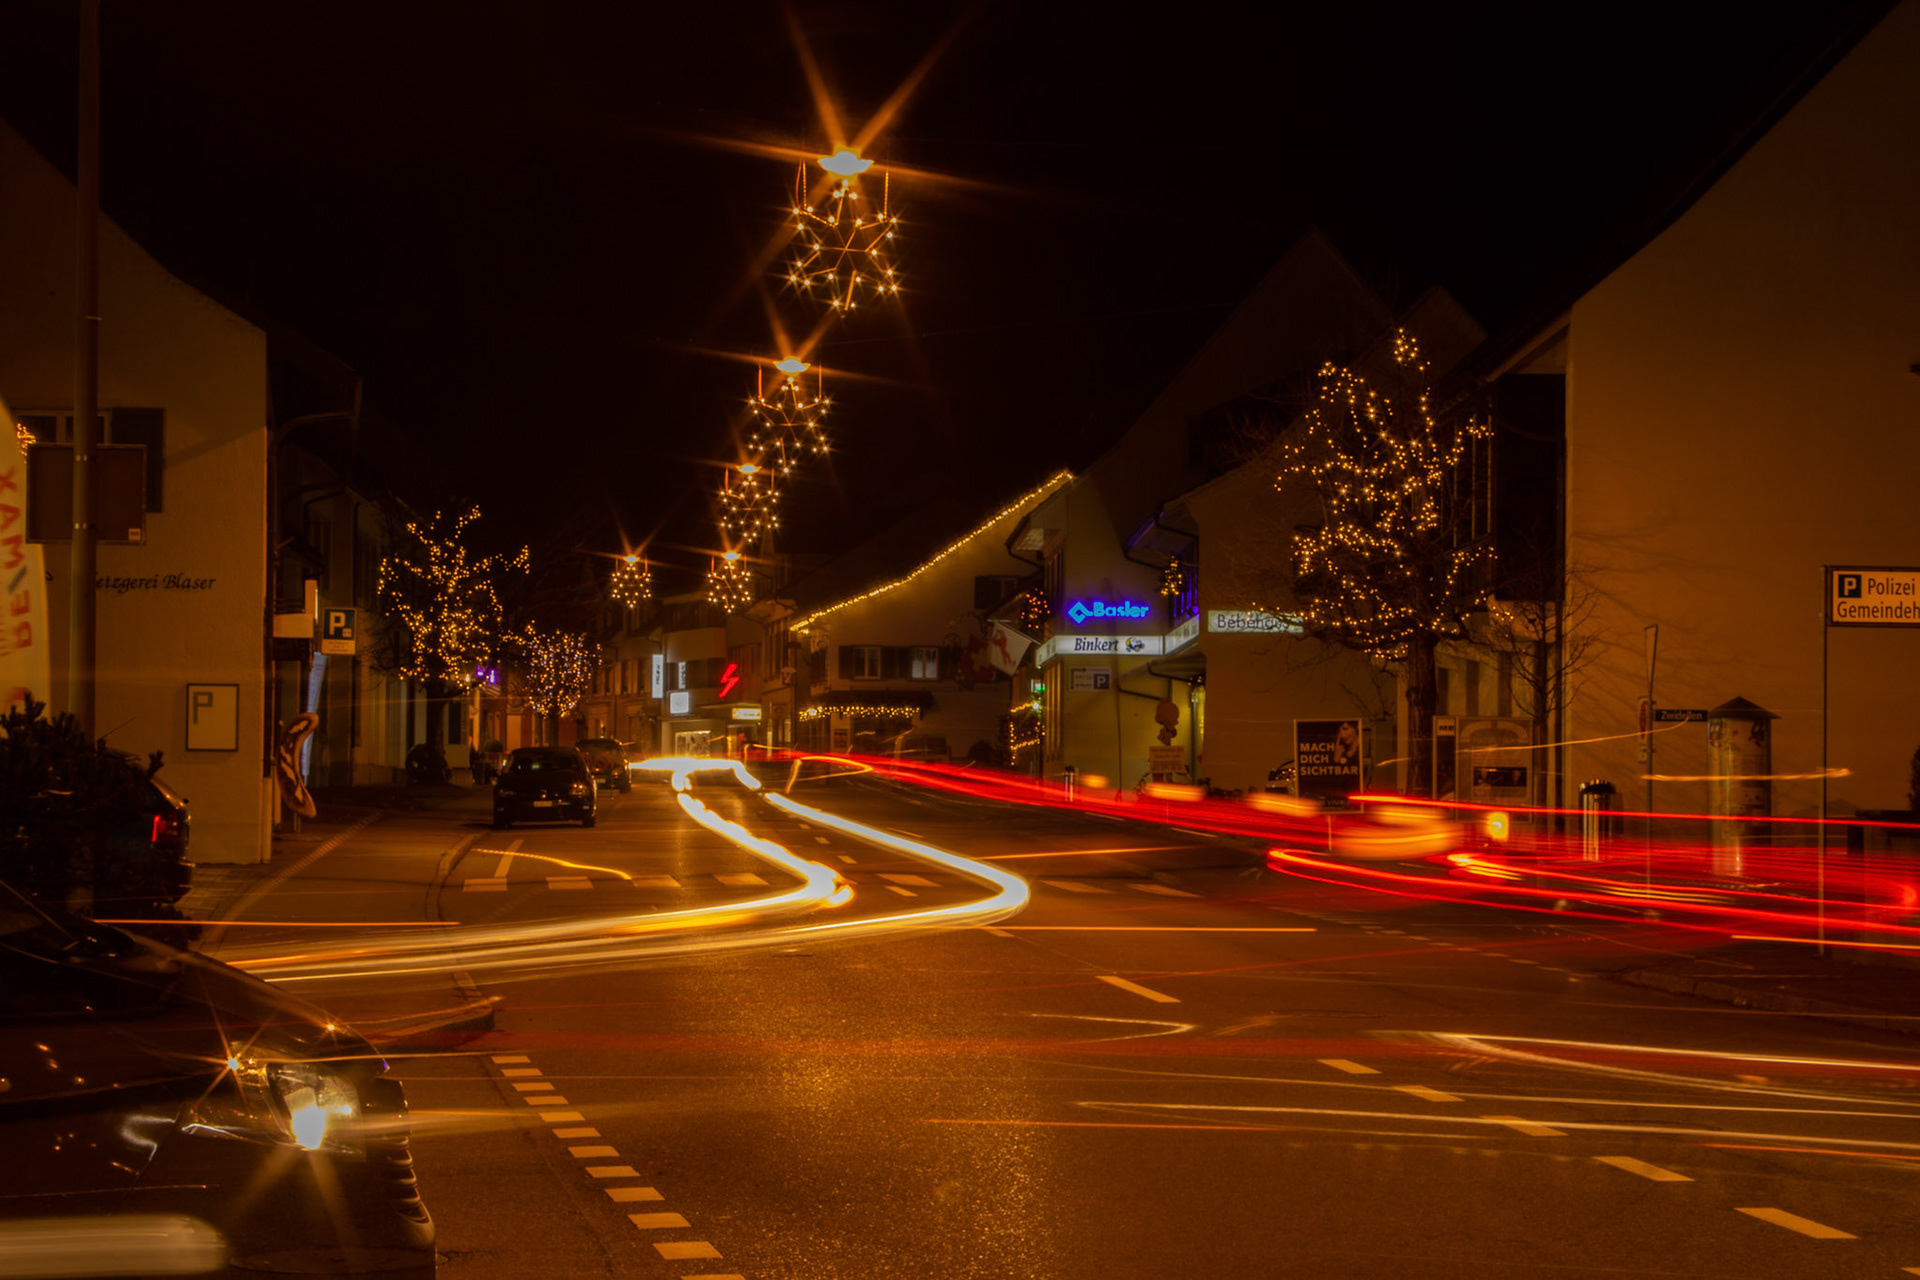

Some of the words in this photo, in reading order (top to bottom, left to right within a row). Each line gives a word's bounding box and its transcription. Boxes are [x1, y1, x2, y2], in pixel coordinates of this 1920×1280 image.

[93, 572, 158, 594] etzgerei
[162, 572, 216, 590] Blaser
[1843, 577, 1857, 596] P
[1868, 577, 1916, 596] Polizei
[1093, 600, 1150, 618] Basler
[1837, 600, 1920, 620] Gemeindeh
[329, 611, 346, 636] P
[1074, 637, 1119, 652] Binkert
[193, 691, 213, 724] P
[1299, 742, 1335, 753] MACH
[1299, 753, 1329, 764] DICH
[1299, 765, 1358, 776] SICHTBAR
